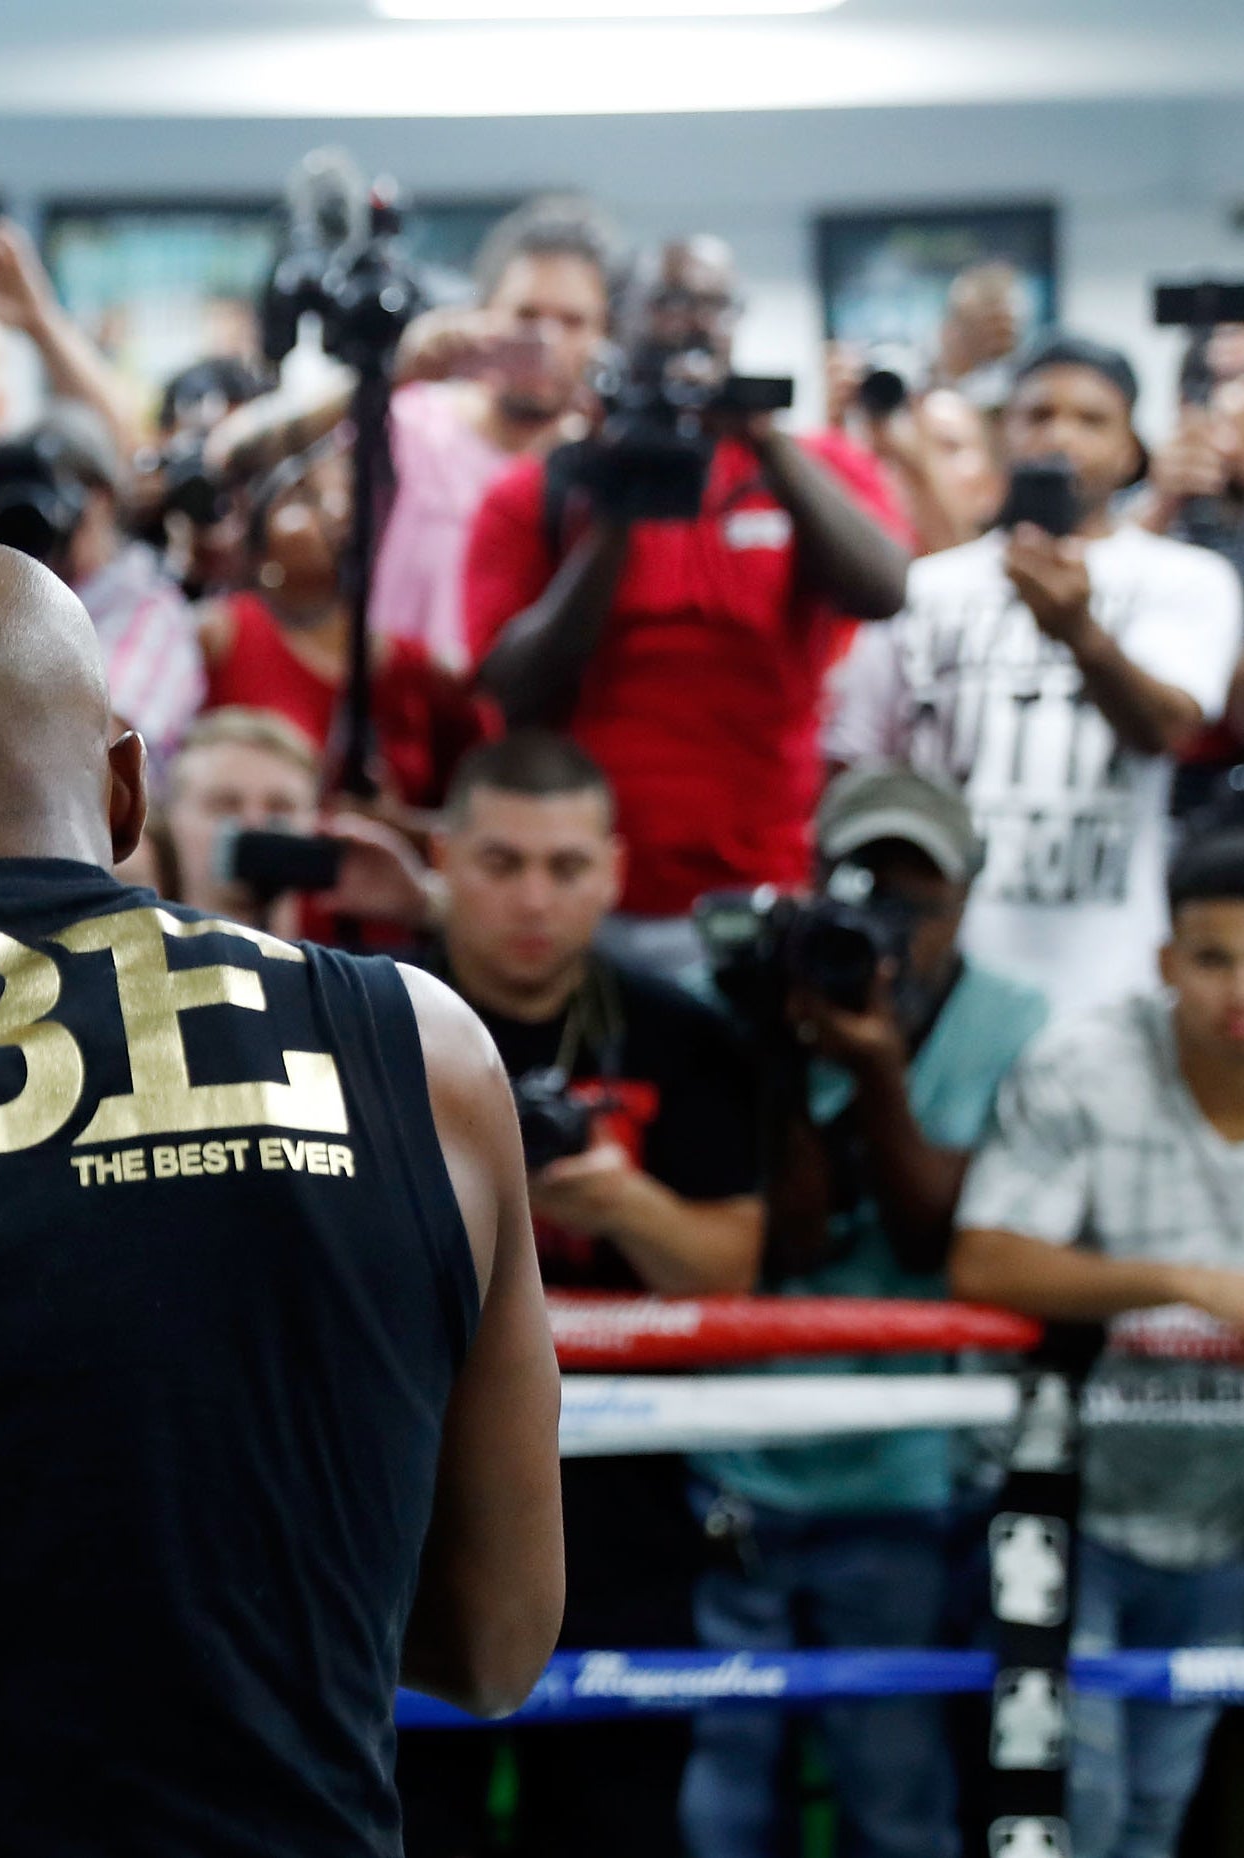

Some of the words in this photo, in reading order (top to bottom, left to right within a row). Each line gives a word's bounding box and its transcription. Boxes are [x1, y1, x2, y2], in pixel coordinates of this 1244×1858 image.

[71, 1148, 147, 1187] THE
[152, 1139, 250, 1179] BEST
[258, 1137, 355, 1178] EVER
